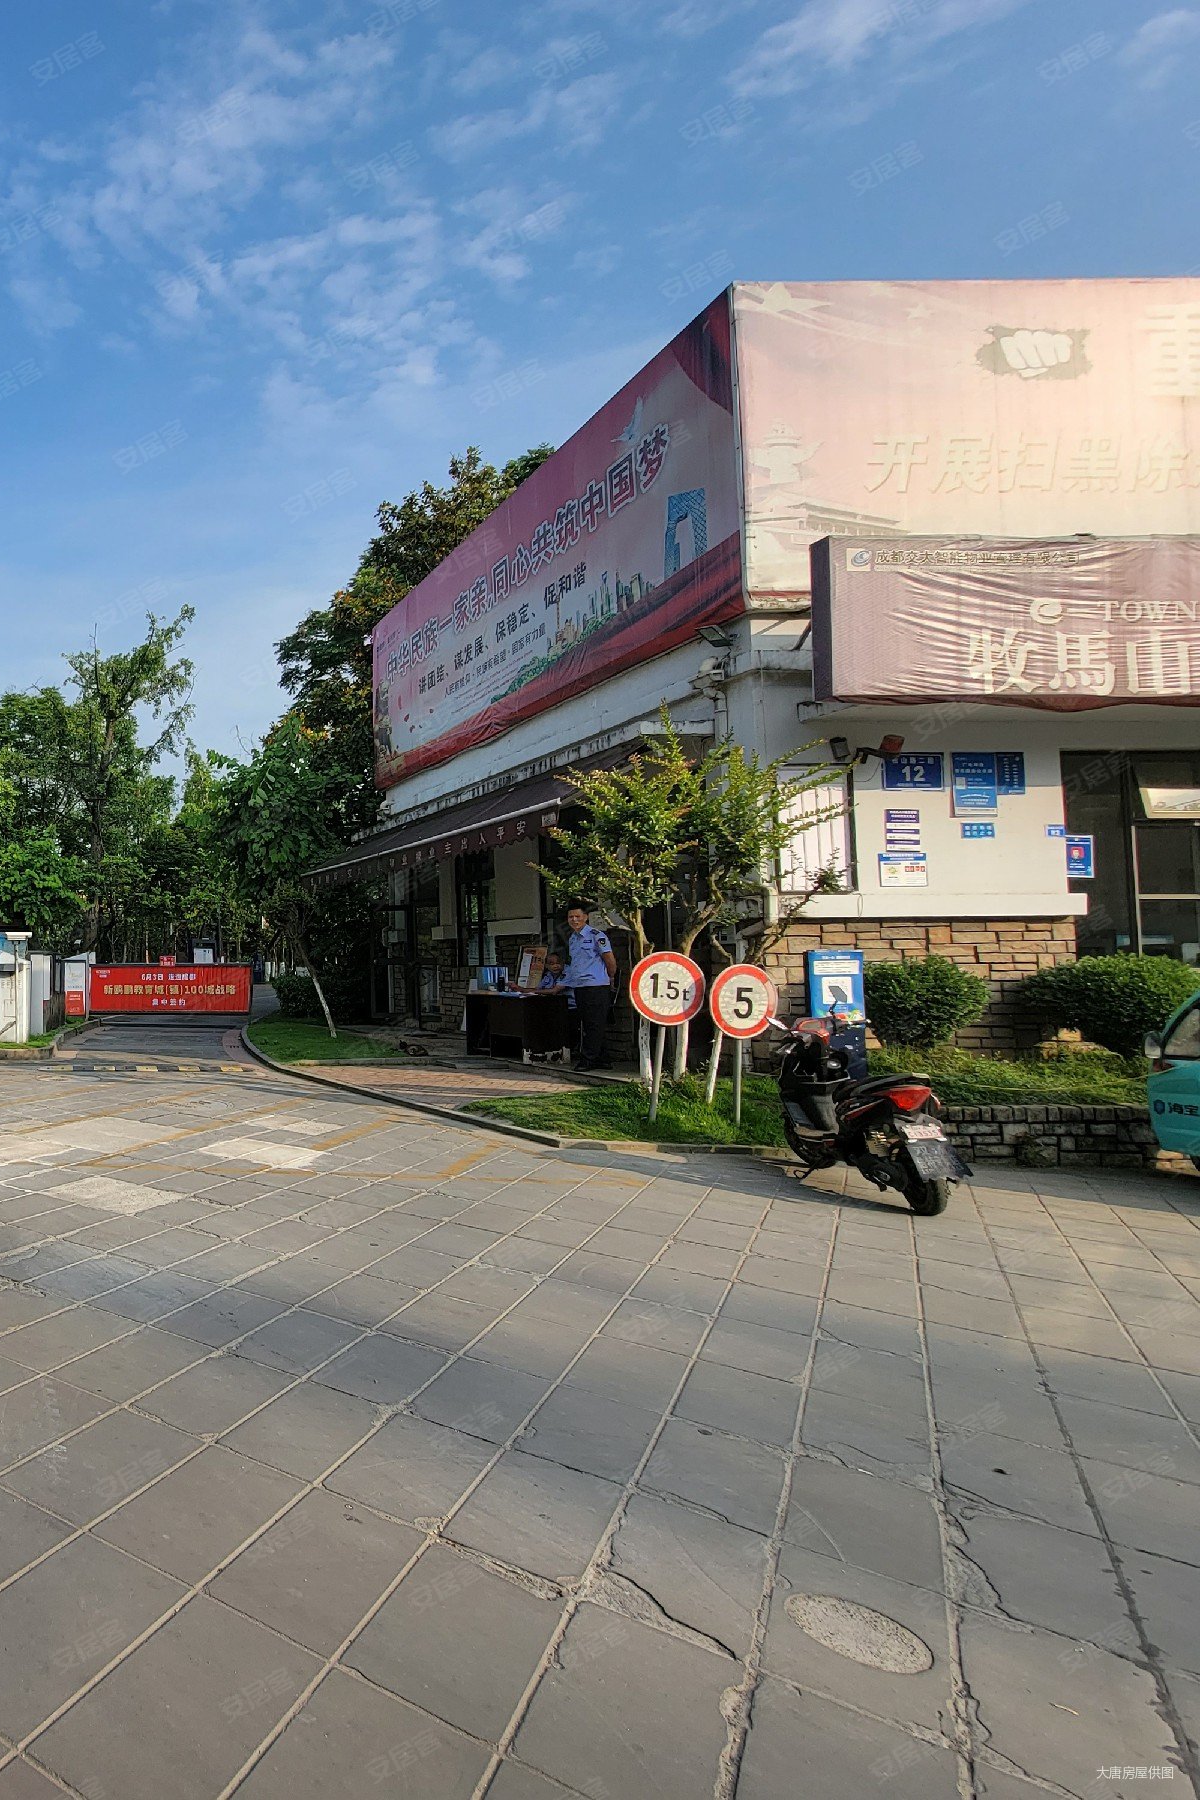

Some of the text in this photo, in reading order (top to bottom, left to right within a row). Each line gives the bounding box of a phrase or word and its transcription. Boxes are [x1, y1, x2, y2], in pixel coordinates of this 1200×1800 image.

[864, 432, 1200, 494] 开展扫黑除
[902, 765, 926, 782] 12
[649, 972, 689, 1001] 1.5t
[734, 987, 753, 1019] 5
